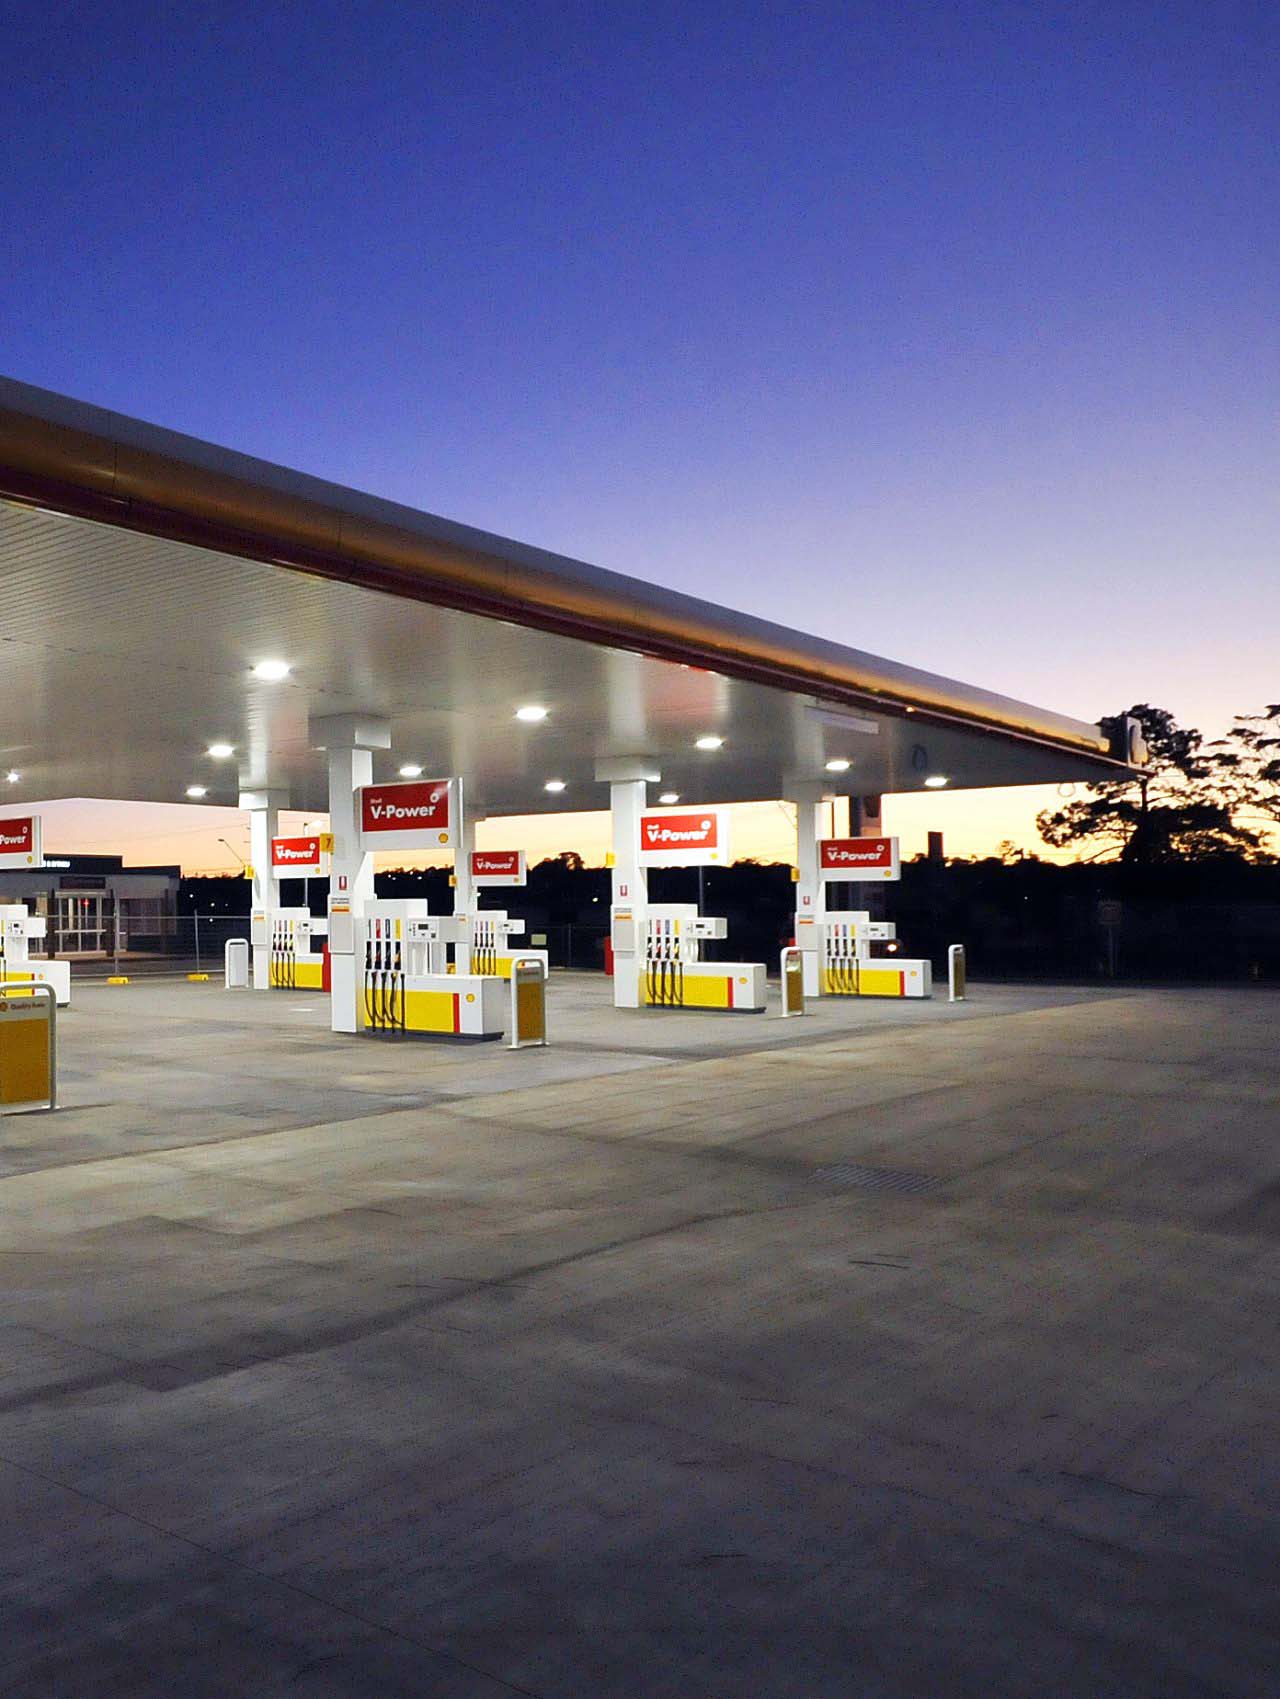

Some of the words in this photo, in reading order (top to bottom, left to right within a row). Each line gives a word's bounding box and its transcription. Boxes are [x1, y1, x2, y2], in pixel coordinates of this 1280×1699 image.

[371, 805, 436, 819] V-Power
[647, 829, 708, 842] V-Power
[326, 838, 331, 849] 7
[276, 849, 314, 859] V-Power
[827, 851, 882, 861] V-Power
